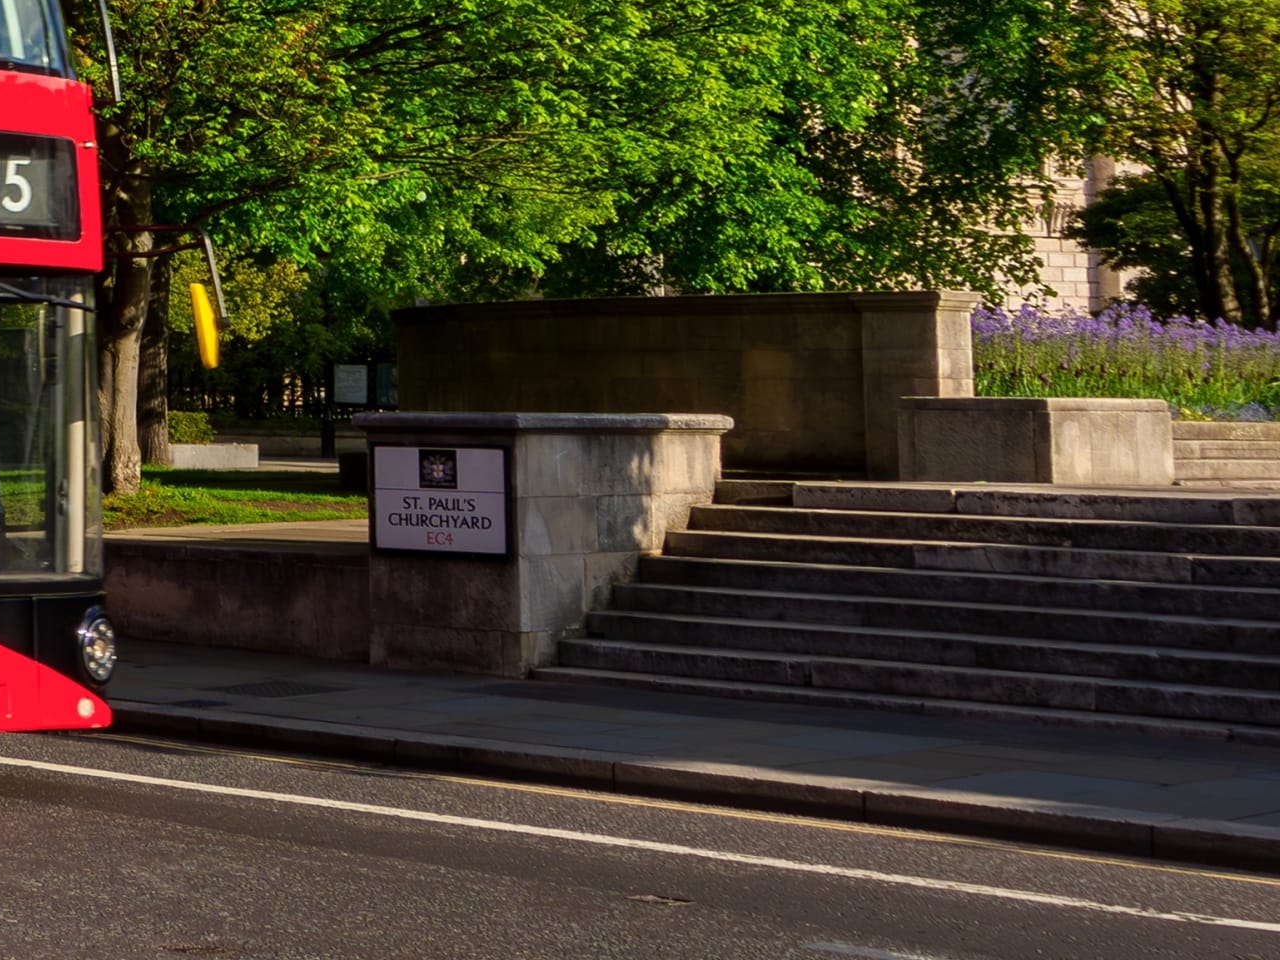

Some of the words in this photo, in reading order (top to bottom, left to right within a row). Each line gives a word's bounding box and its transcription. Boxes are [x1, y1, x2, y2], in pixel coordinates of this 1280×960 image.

[402, 496, 423, 510] ST.
[428, 497, 476, 512] PAUL'S
[388, 512, 492, 530] CHURCHYARD
[426, 531, 454, 545] EC4
